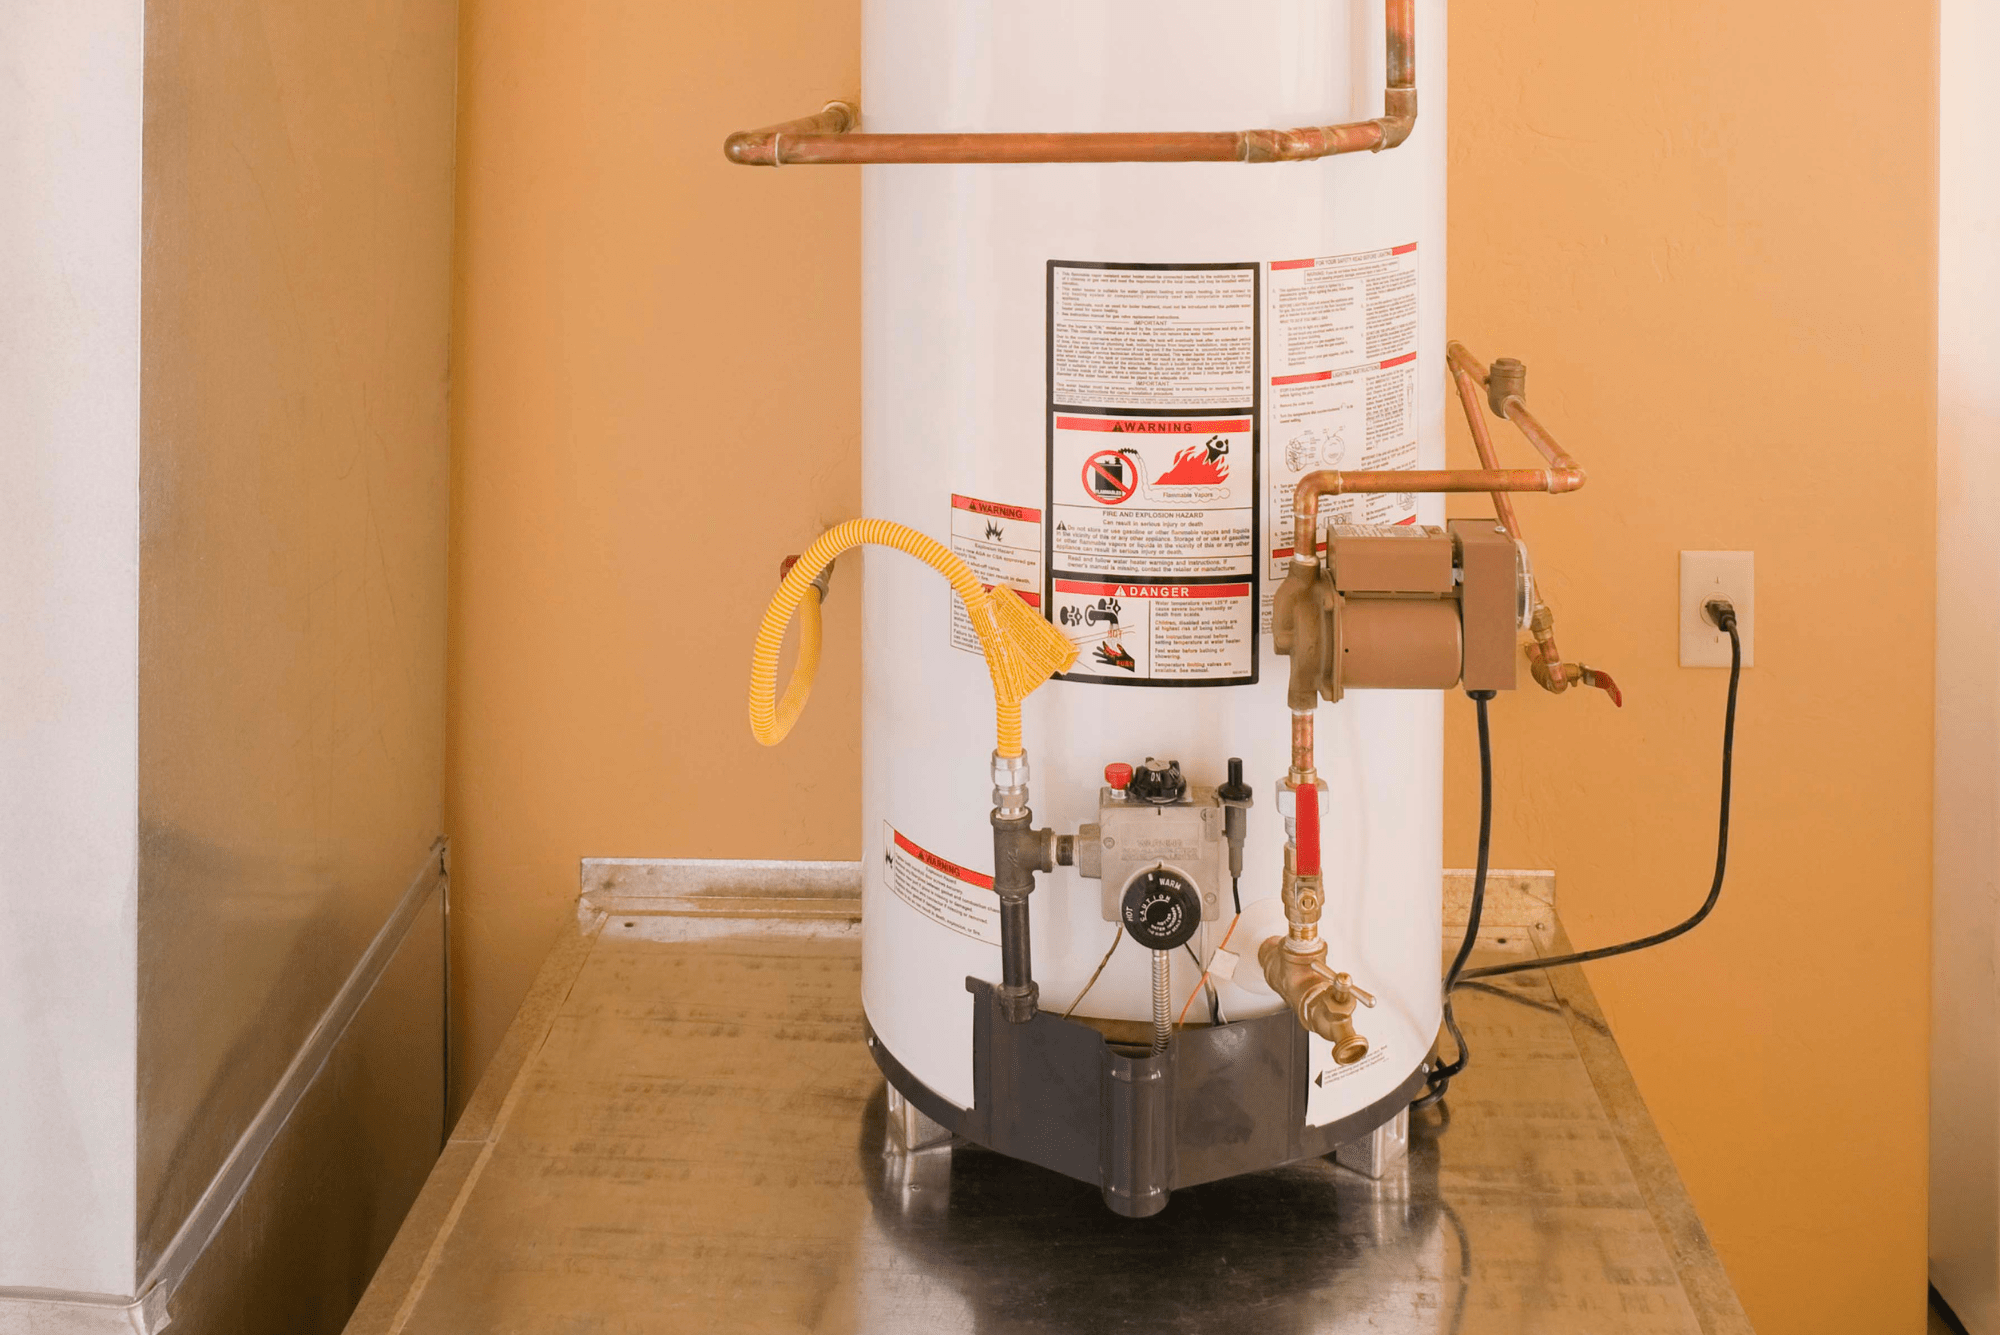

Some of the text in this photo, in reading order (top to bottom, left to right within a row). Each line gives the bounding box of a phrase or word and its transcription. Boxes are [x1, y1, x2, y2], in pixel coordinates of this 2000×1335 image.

[1125, 422, 1192, 432] WARNING
[979, 502, 1023, 518] WARNING
[1130, 587, 1189, 596] DANGER
[1151, 772, 1161, 782] ON
[926, 854, 960, 877] WARNING
[1159, 878, 1181, 890] WARM
[1140, 894, 1171, 922] CAUTION
